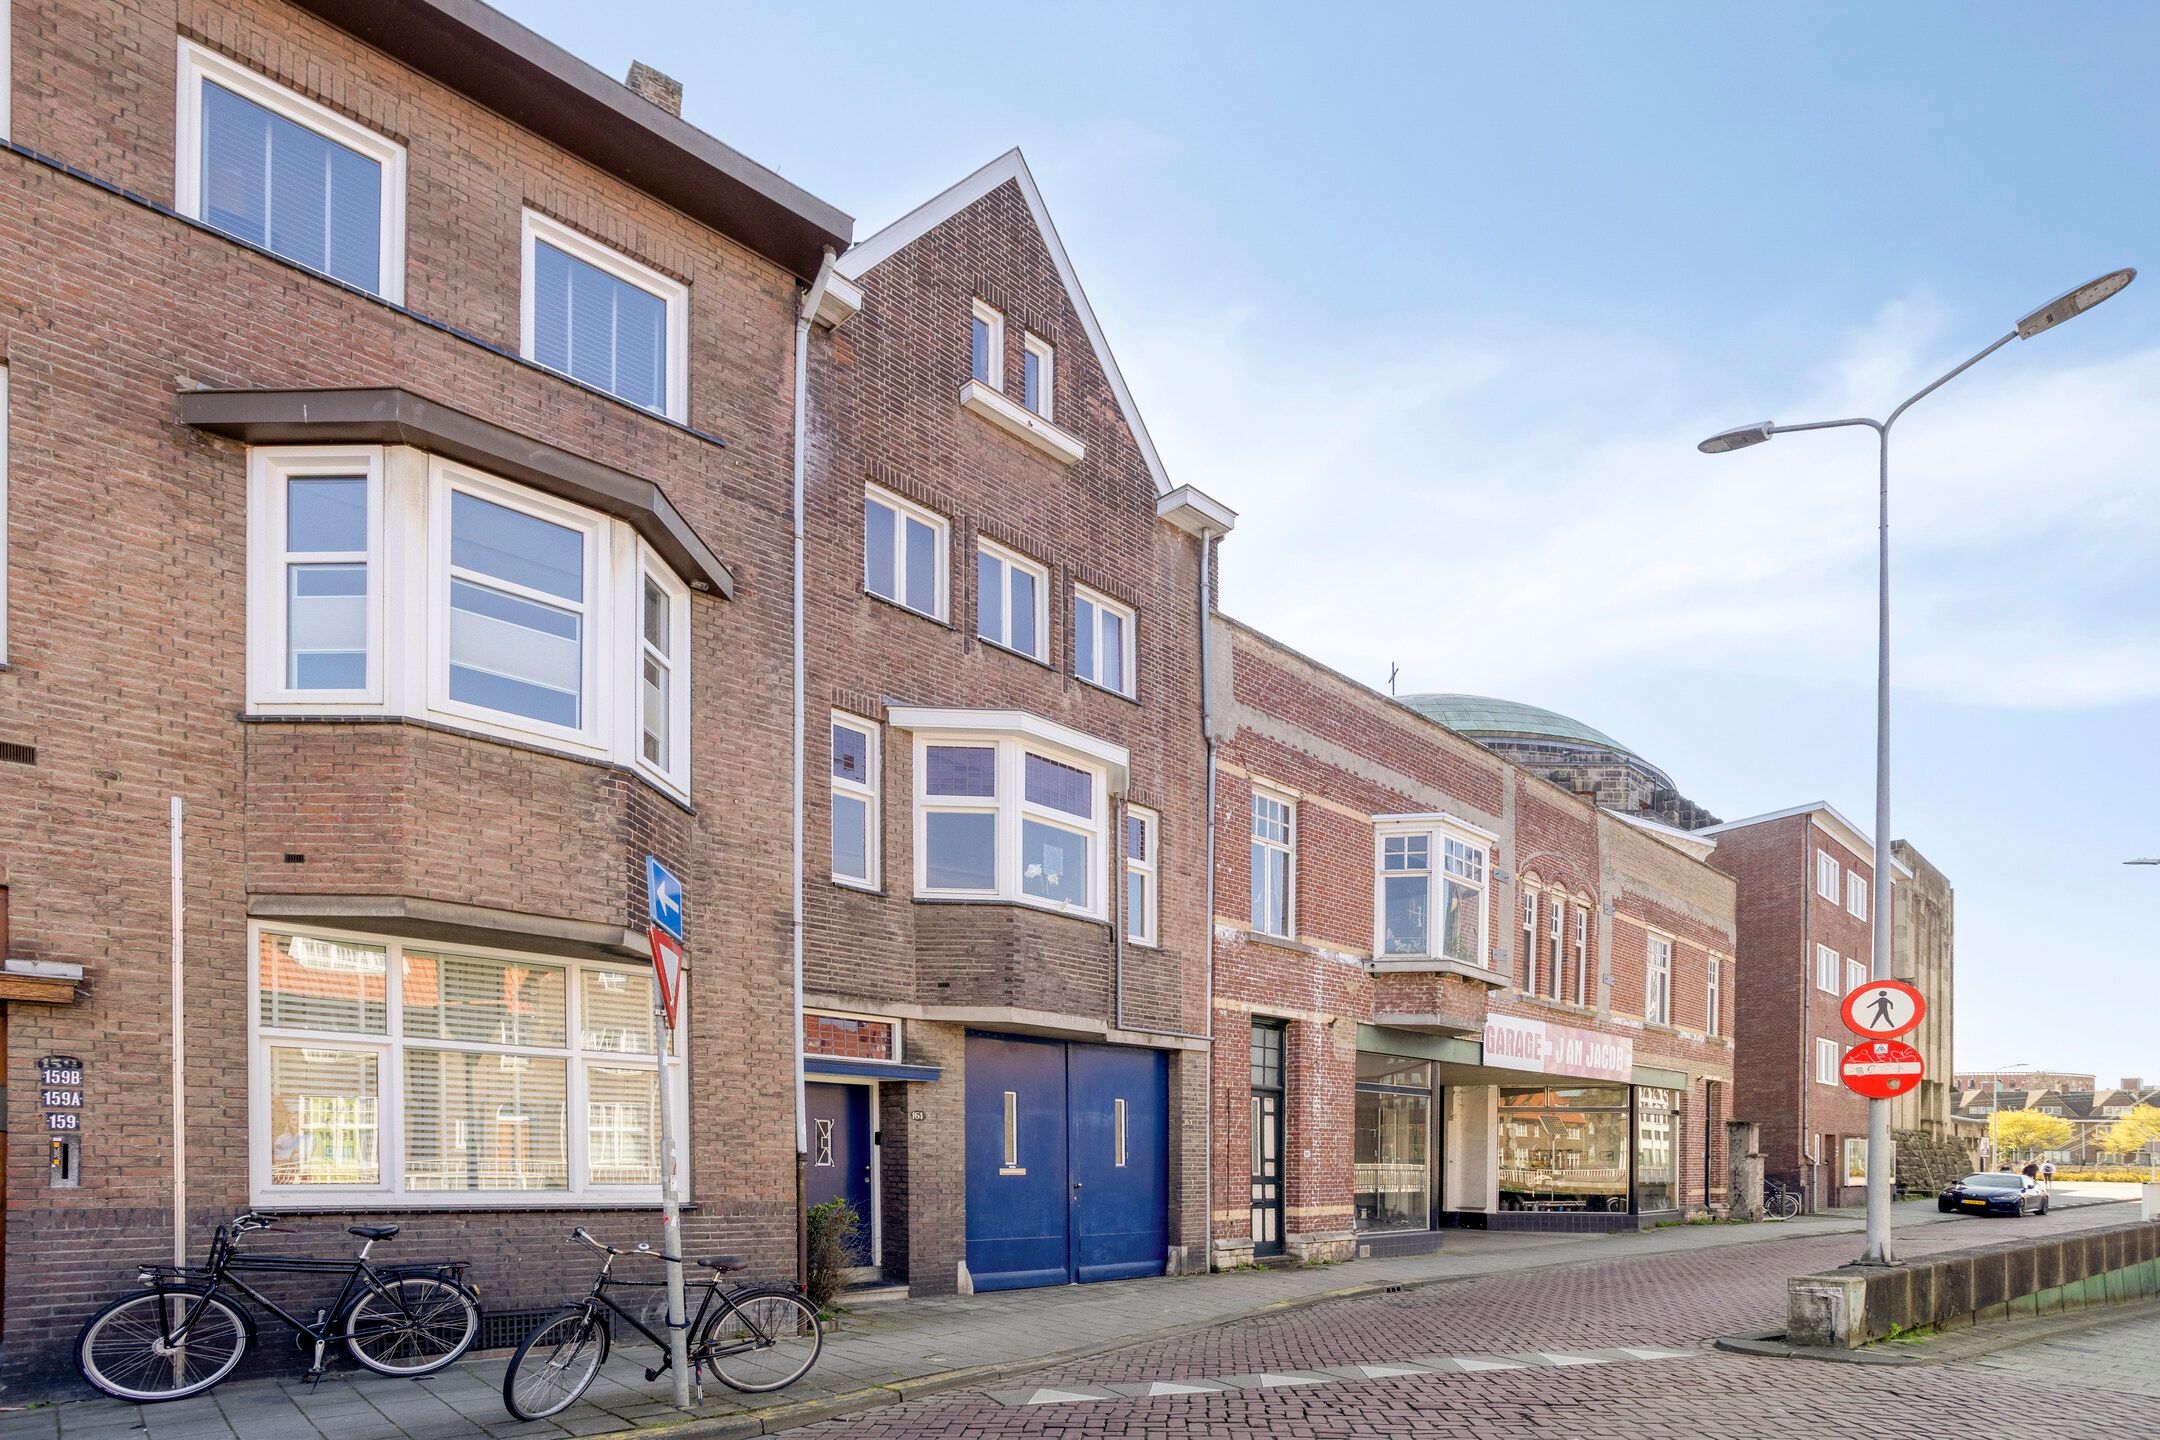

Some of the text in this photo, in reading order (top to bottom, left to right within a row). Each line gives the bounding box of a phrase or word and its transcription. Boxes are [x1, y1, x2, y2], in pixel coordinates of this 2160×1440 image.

[1485, 1025, 1542, 1061] GARAGE
[1555, 1037, 1583, 1066] JAN
[44, 1070, 80, 1084] 159B
[44, 1091, 80, 1106] 159A
[49, 1114, 76, 1129] 159
